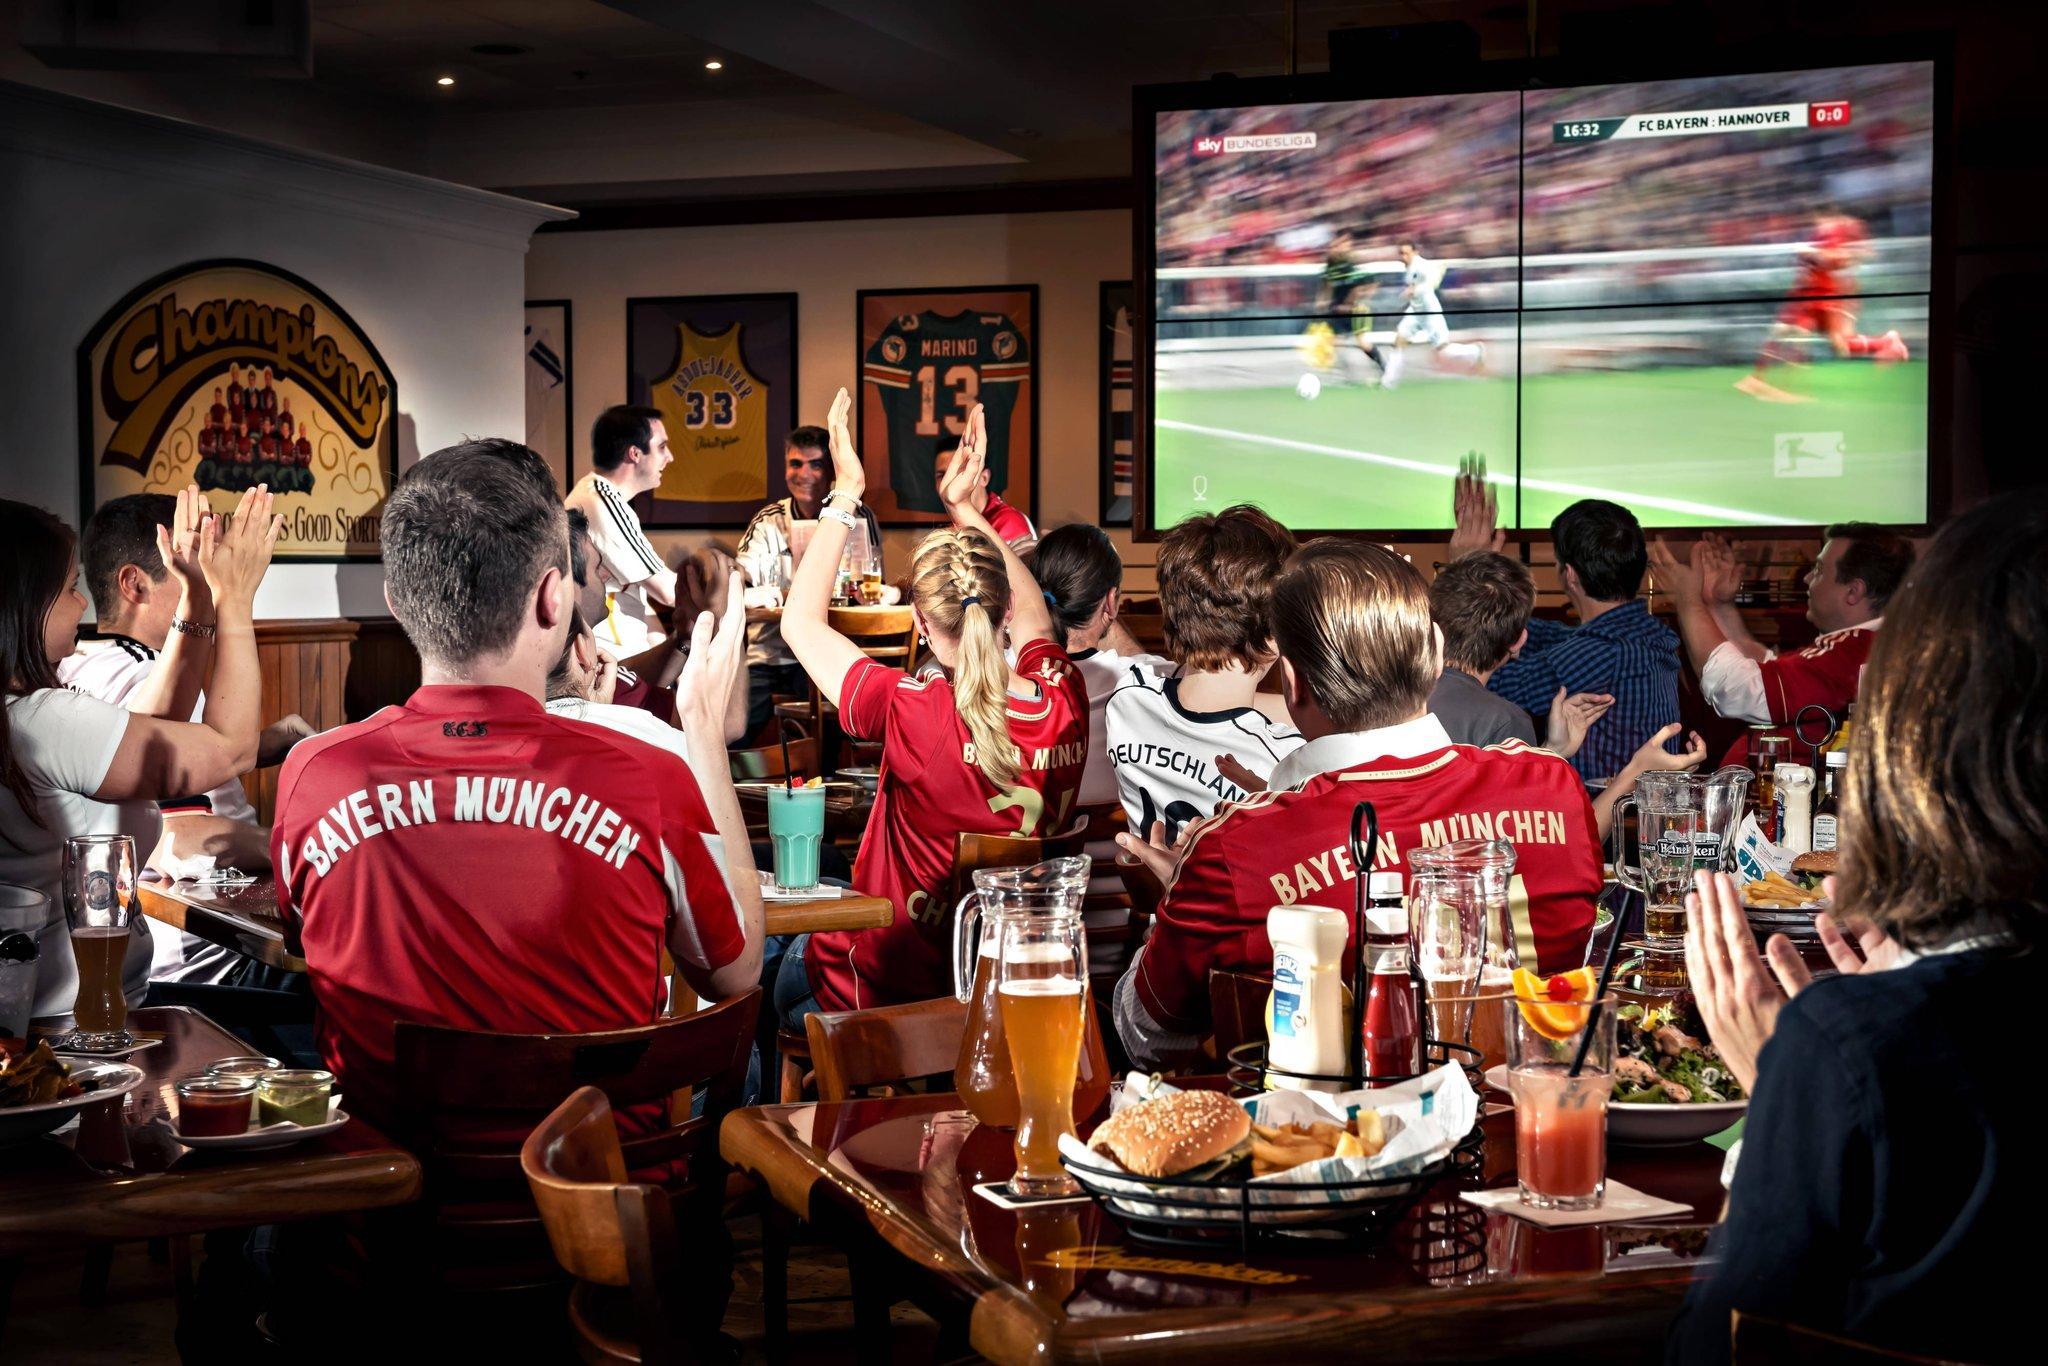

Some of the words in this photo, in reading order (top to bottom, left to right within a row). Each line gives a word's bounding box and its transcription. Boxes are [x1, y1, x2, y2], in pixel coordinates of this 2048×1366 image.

[1198, 138, 1222, 153] sky
[1227, 136, 1312, 149] BUNDESLIGA
[1563, 124, 1600, 137] 16:32
[1639, 119, 1653, 131] FC
[1657, 115, 1708, 130] BAYERN
[1719, 111, 1790, 126] HANNOVER
[1816, 108, 1842, 122] 0:0
[102, 292, 387, 440] Champions
[921, 339, 977, 356] MARINO
[685, 390, 737, 429] 33
[915, 365, 979, 436] 13
[1108, 743, 1246, 802] DEUTSCHLAN
[303, 779, 437, 878] BAYERN
[454, 776, 641, 870] MÜNCHEN
